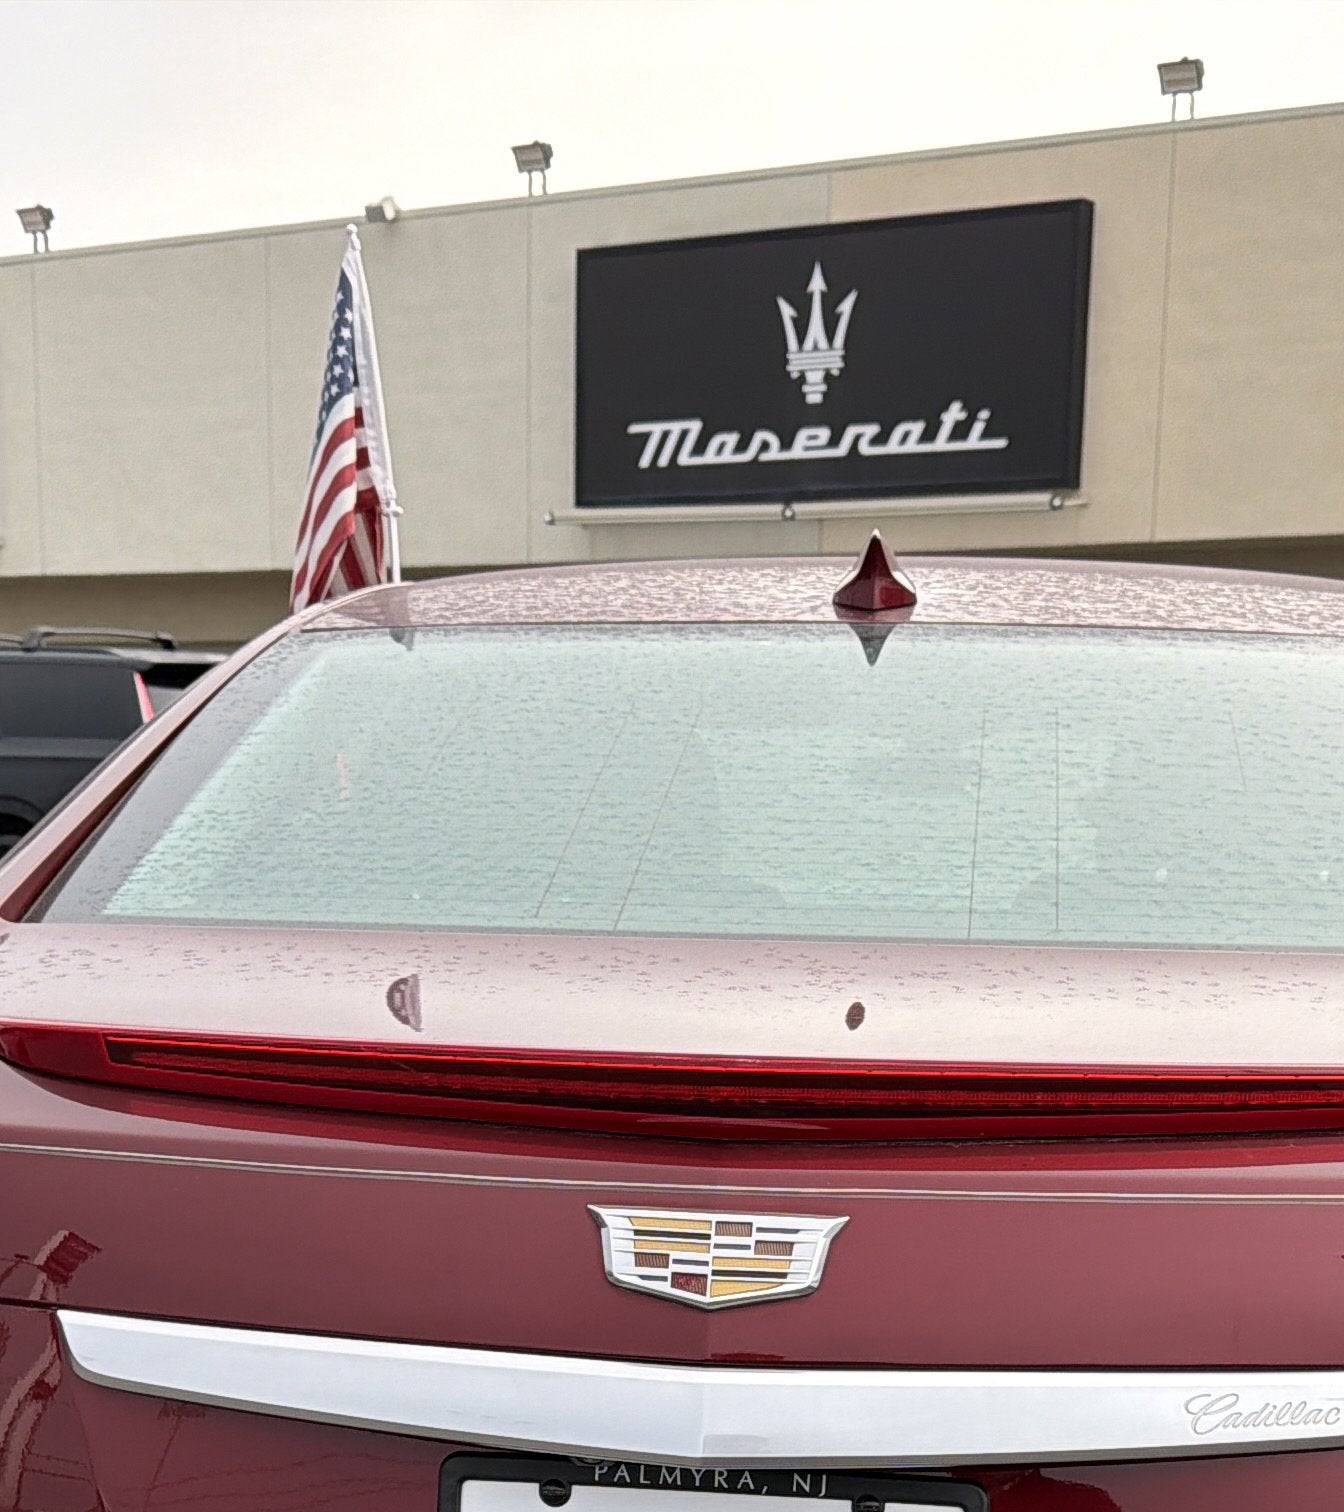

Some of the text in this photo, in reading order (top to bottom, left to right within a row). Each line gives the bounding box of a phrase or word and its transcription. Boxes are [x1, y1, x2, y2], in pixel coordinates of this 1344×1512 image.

[627, 400, 1009, 469] Maserati
[1184, 1392, 1341, 1435] Cadillac
[594, 1463, 828, 1497] PALMYRA, NJ
